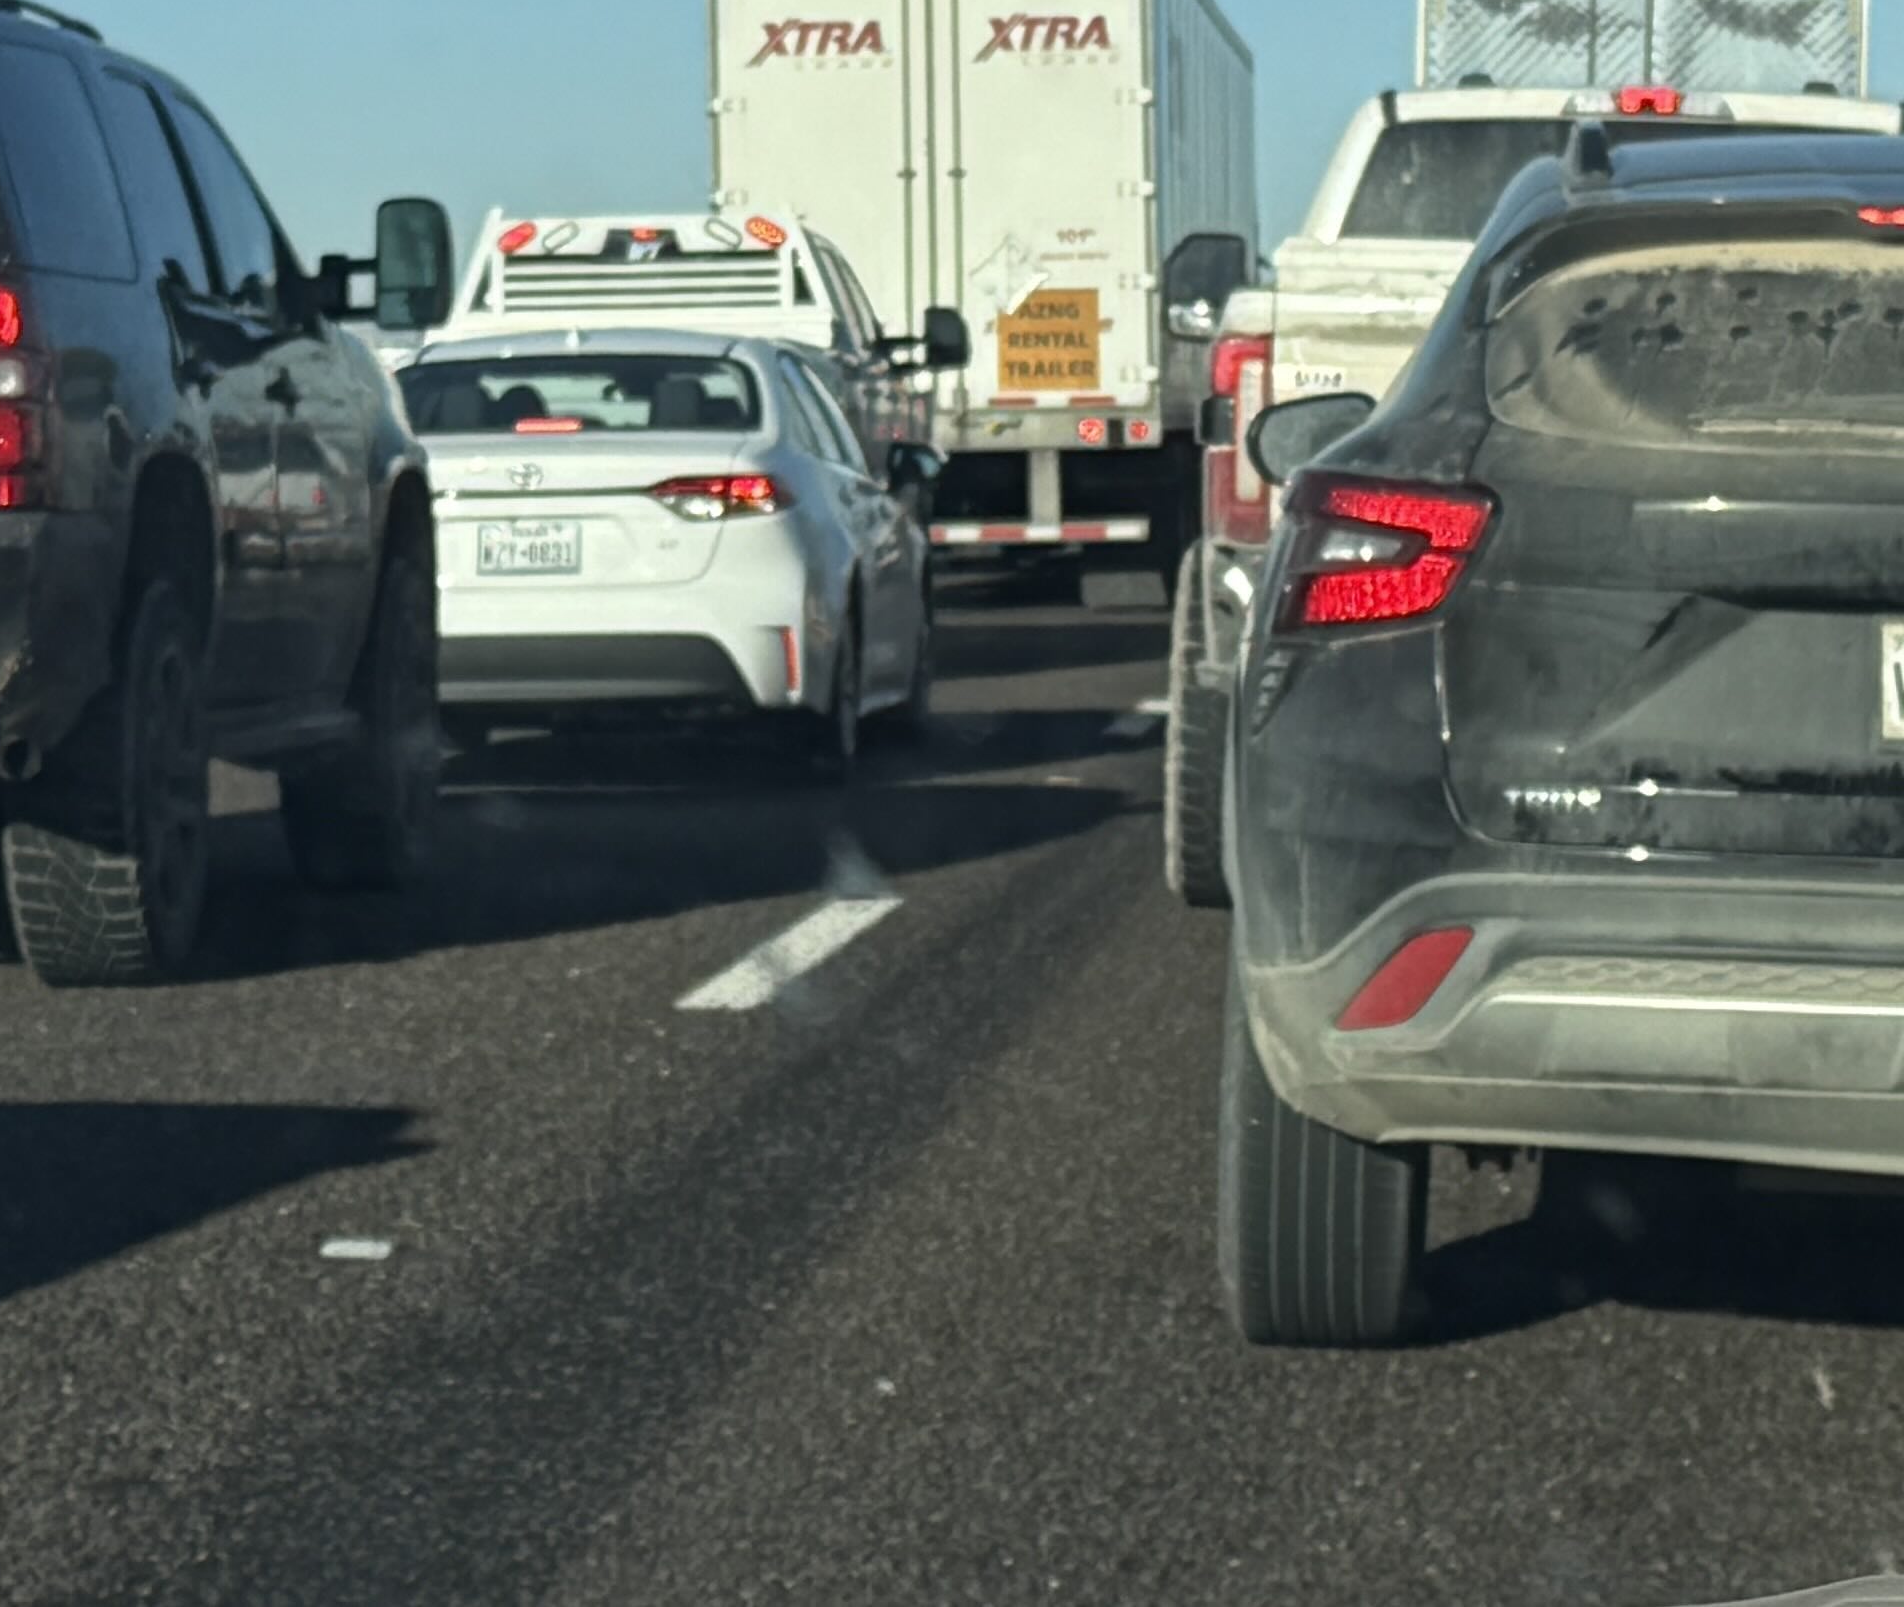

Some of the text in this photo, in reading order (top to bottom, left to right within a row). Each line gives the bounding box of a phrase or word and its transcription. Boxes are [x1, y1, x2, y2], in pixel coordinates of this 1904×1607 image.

[745, 18, 886, 69] XTRA
[972, 13, 1111, 64] XTRA
[1007, 332, 1089, 348] RENTAL
[1006, 361, 1095, 377] TRAILER
